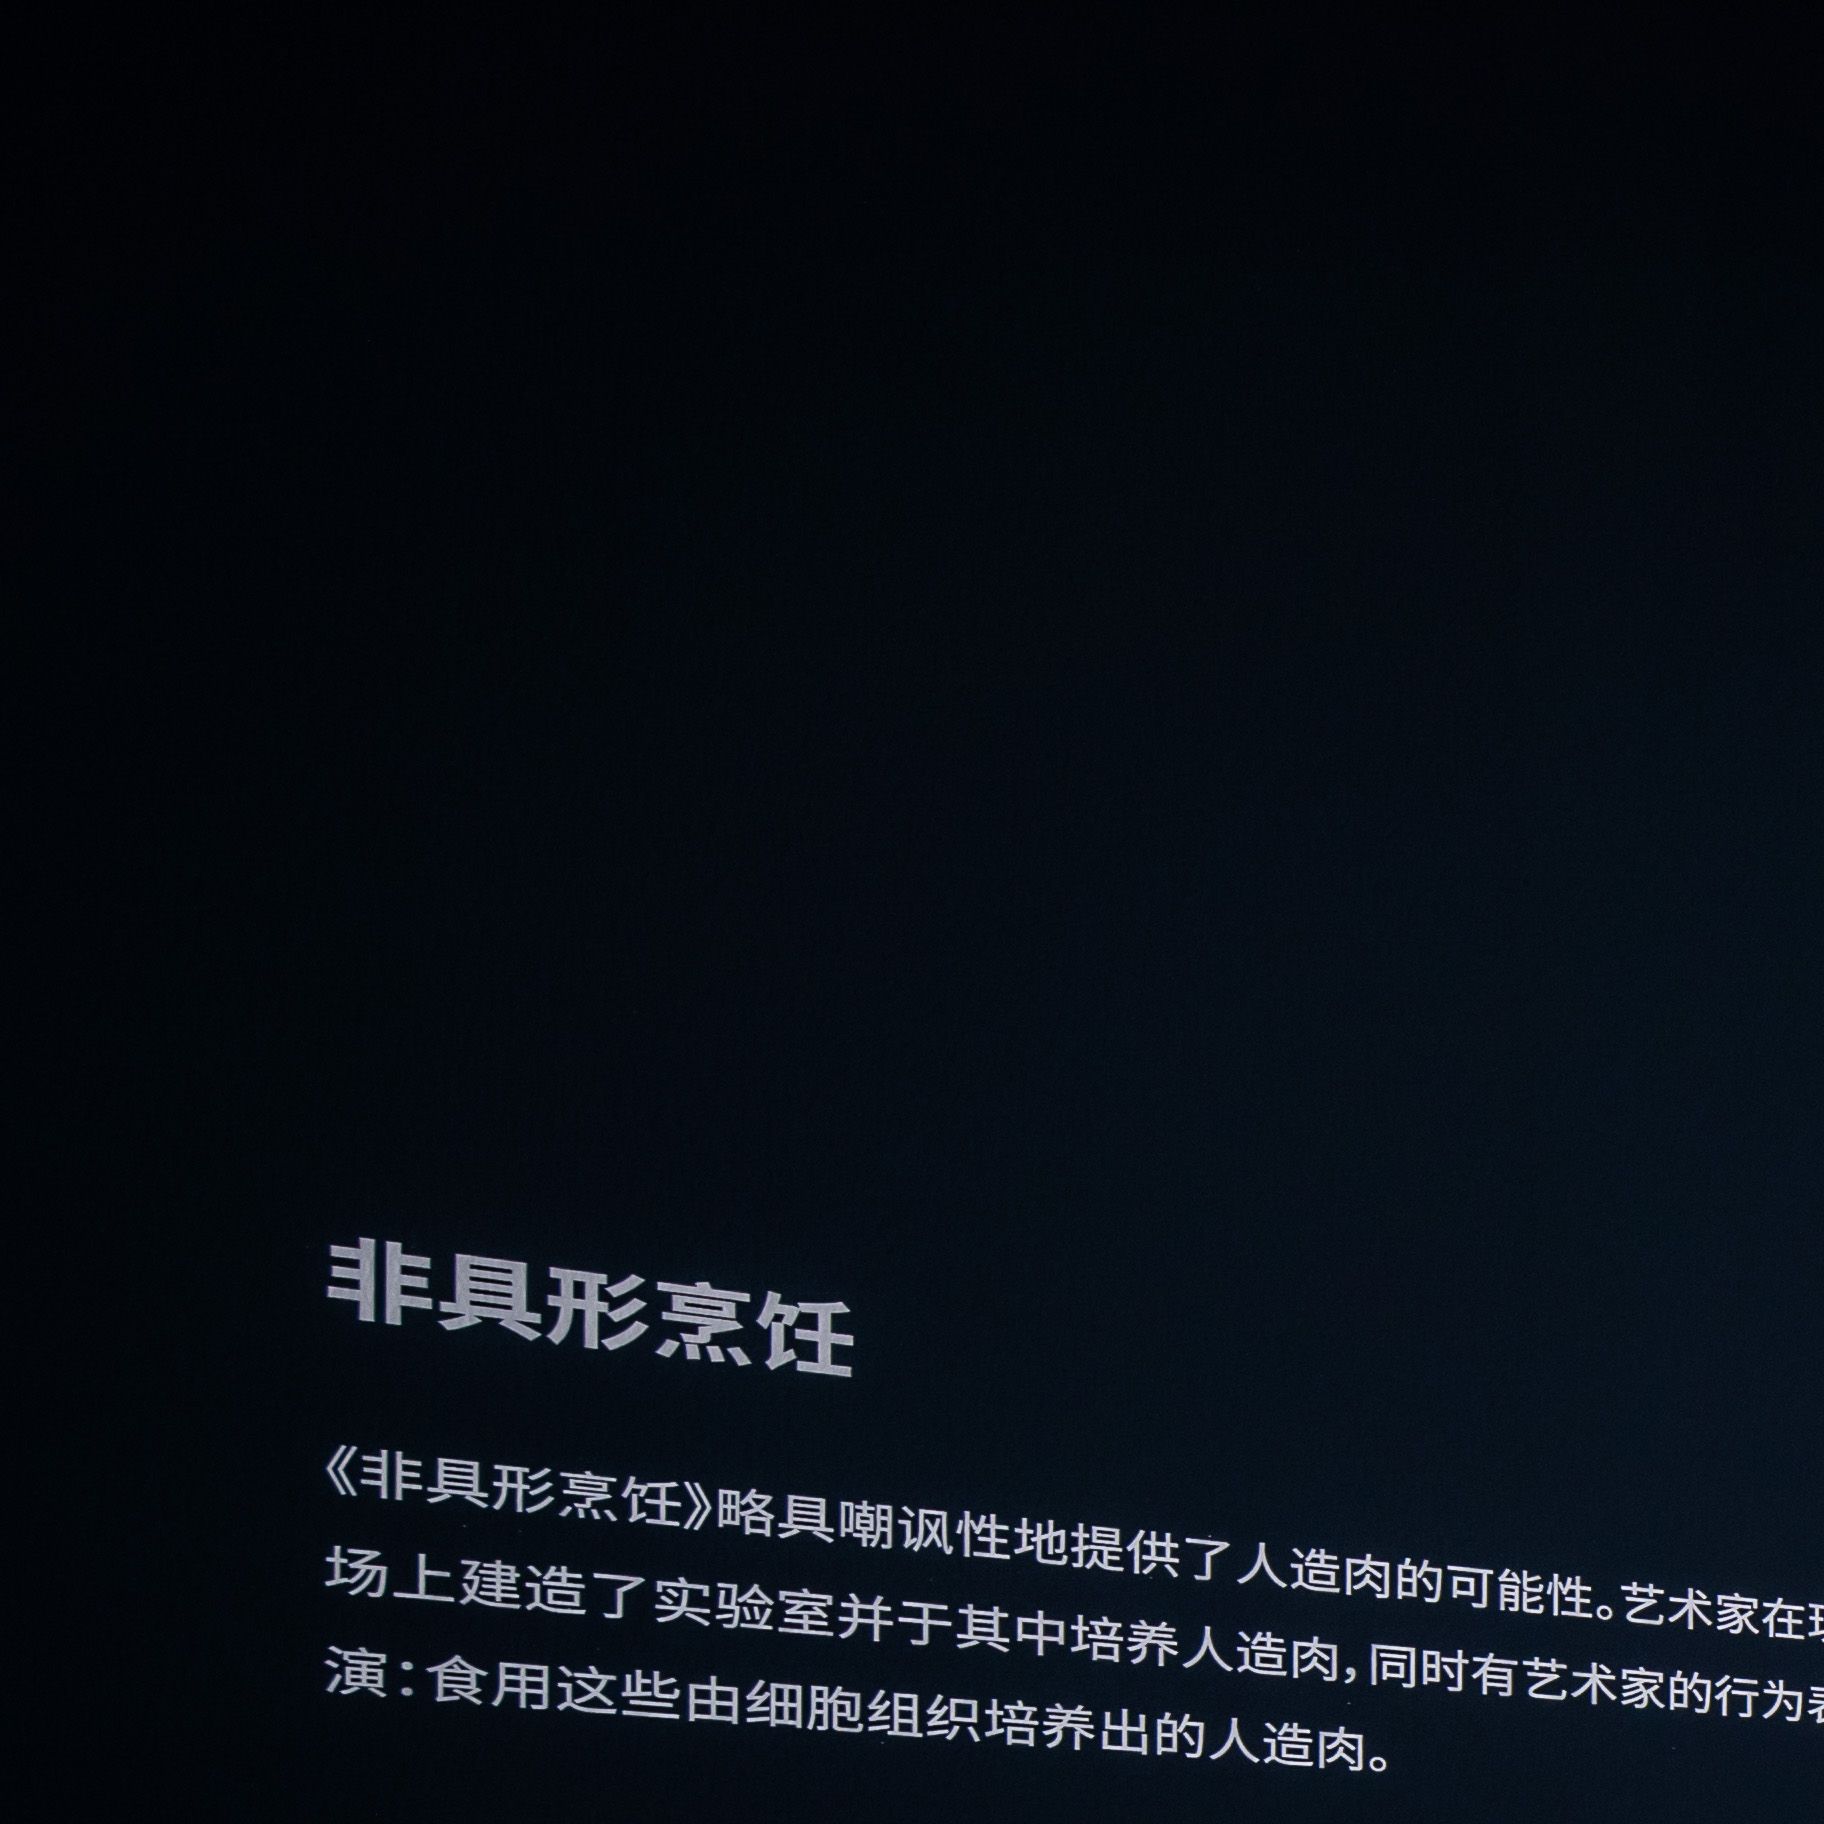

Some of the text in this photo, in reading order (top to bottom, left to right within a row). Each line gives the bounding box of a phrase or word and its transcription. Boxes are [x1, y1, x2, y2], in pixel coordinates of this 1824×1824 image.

[326, 1236, 855, 1378] 非具形烹饪
